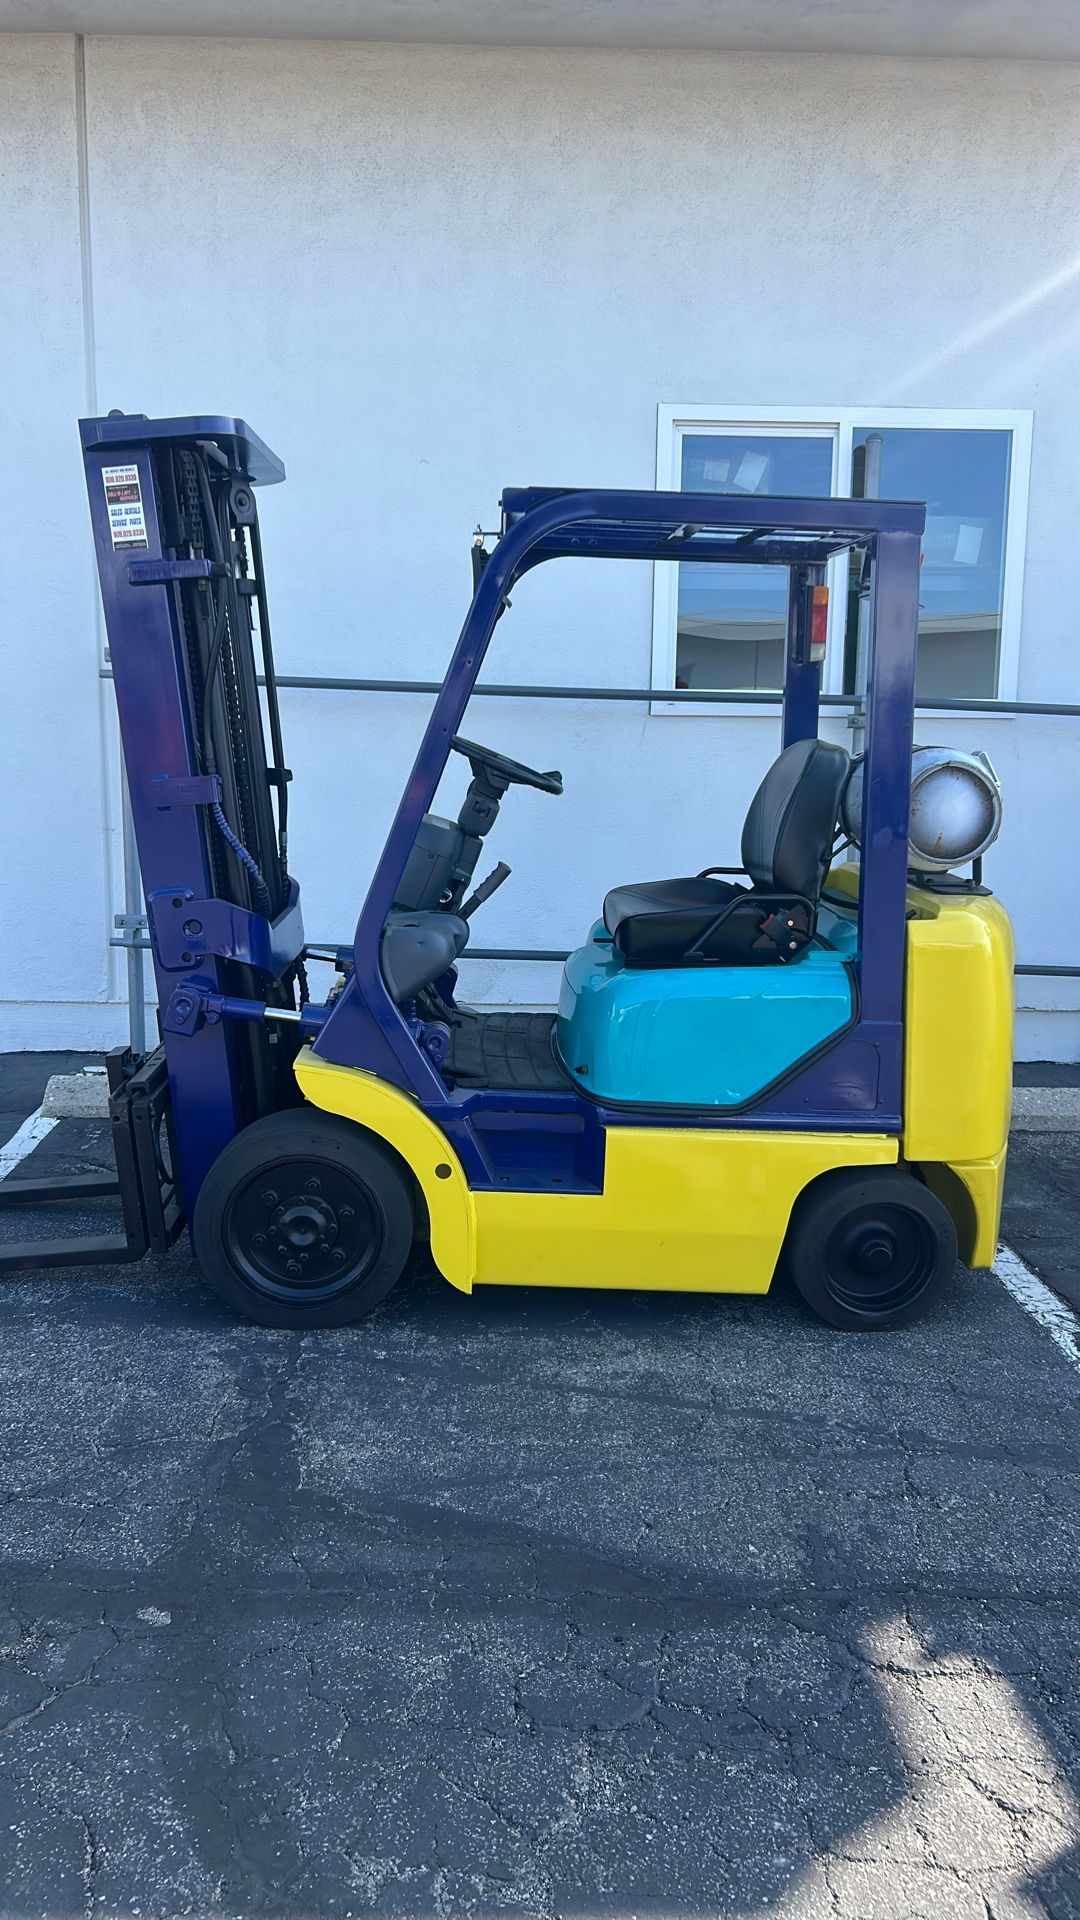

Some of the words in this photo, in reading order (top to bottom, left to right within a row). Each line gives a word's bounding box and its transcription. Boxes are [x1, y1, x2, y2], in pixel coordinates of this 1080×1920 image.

[110, 508, 123, 517] SALES
[124, 506, 141, 516] RENTALS
[112, 519, 128, 527] SERVICE
[129, 517, 142, 526] PARTS
